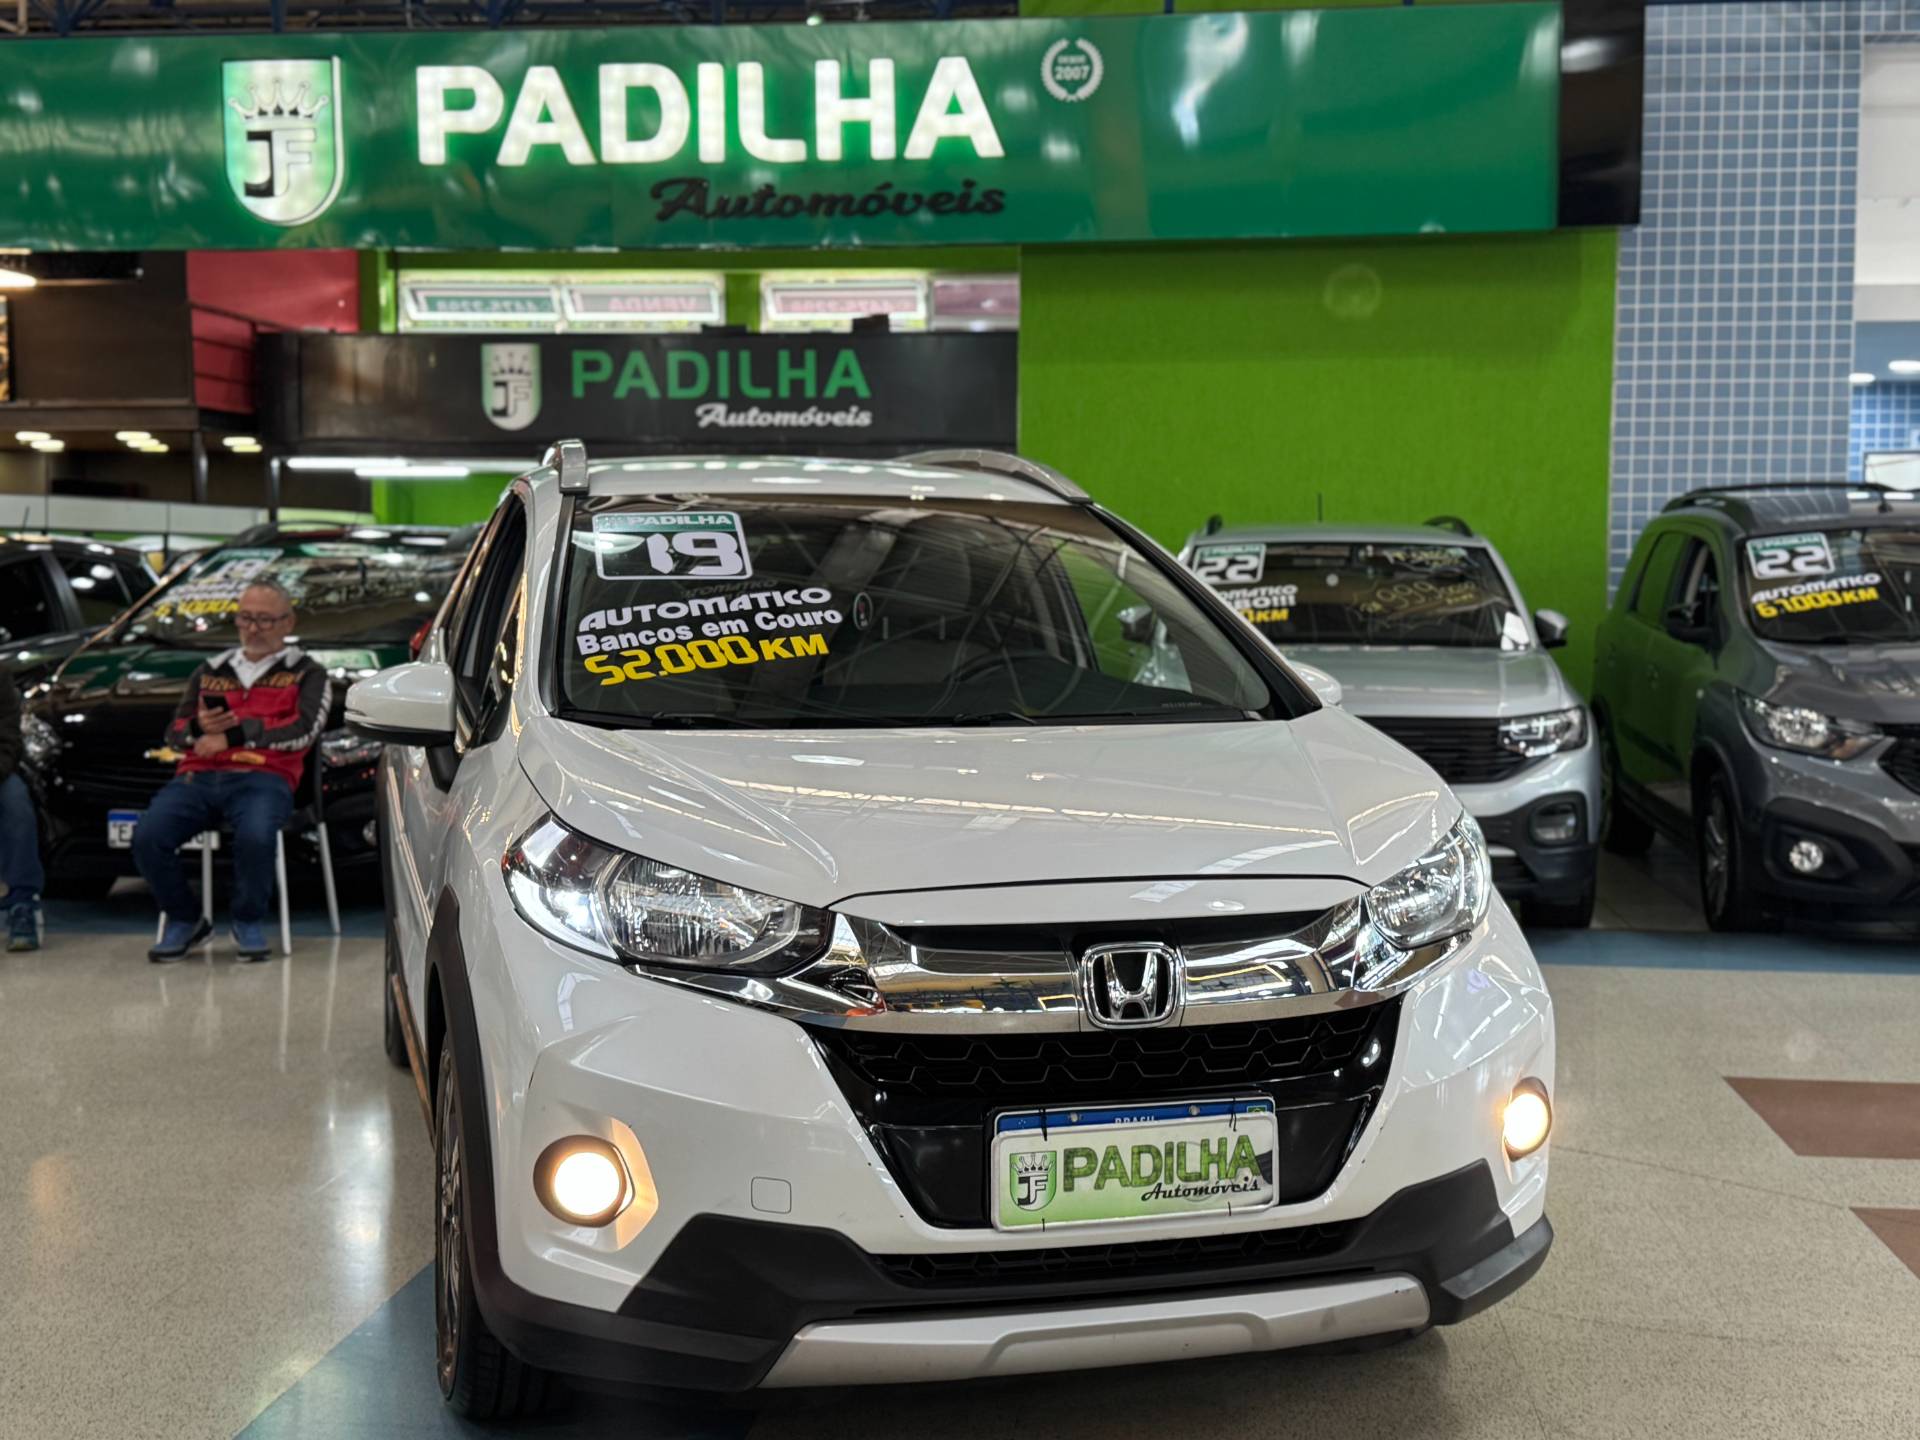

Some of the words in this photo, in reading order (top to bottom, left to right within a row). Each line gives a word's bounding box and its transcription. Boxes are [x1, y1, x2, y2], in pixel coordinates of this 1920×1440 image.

[1055, 65, 1090, 81] 2007
[416, 56, 1005, 167] PADILHA
[650, 177, 1005, 222] Automóveis
[571, 349, 871, 399] PADILHA
[695, 403, 872, 427] Automóveis
[627, 515, 732, 525] PADILHA
[1197, 555, 1259, 581] 22
[1757, 545, 1827, 575] 22
[579, 587, 832, 632] AUTOMATICO
[1226, 595, 1297, 609] BO!!!
[576, 621, 693, 656] Bancos
[701, 617, 749, 637] em
[755, 609, 843, 631] Couro
[1063, 1134, 1262, 1193] PADILHA
[1141, 1176, 1261, 1202] Automóveis
